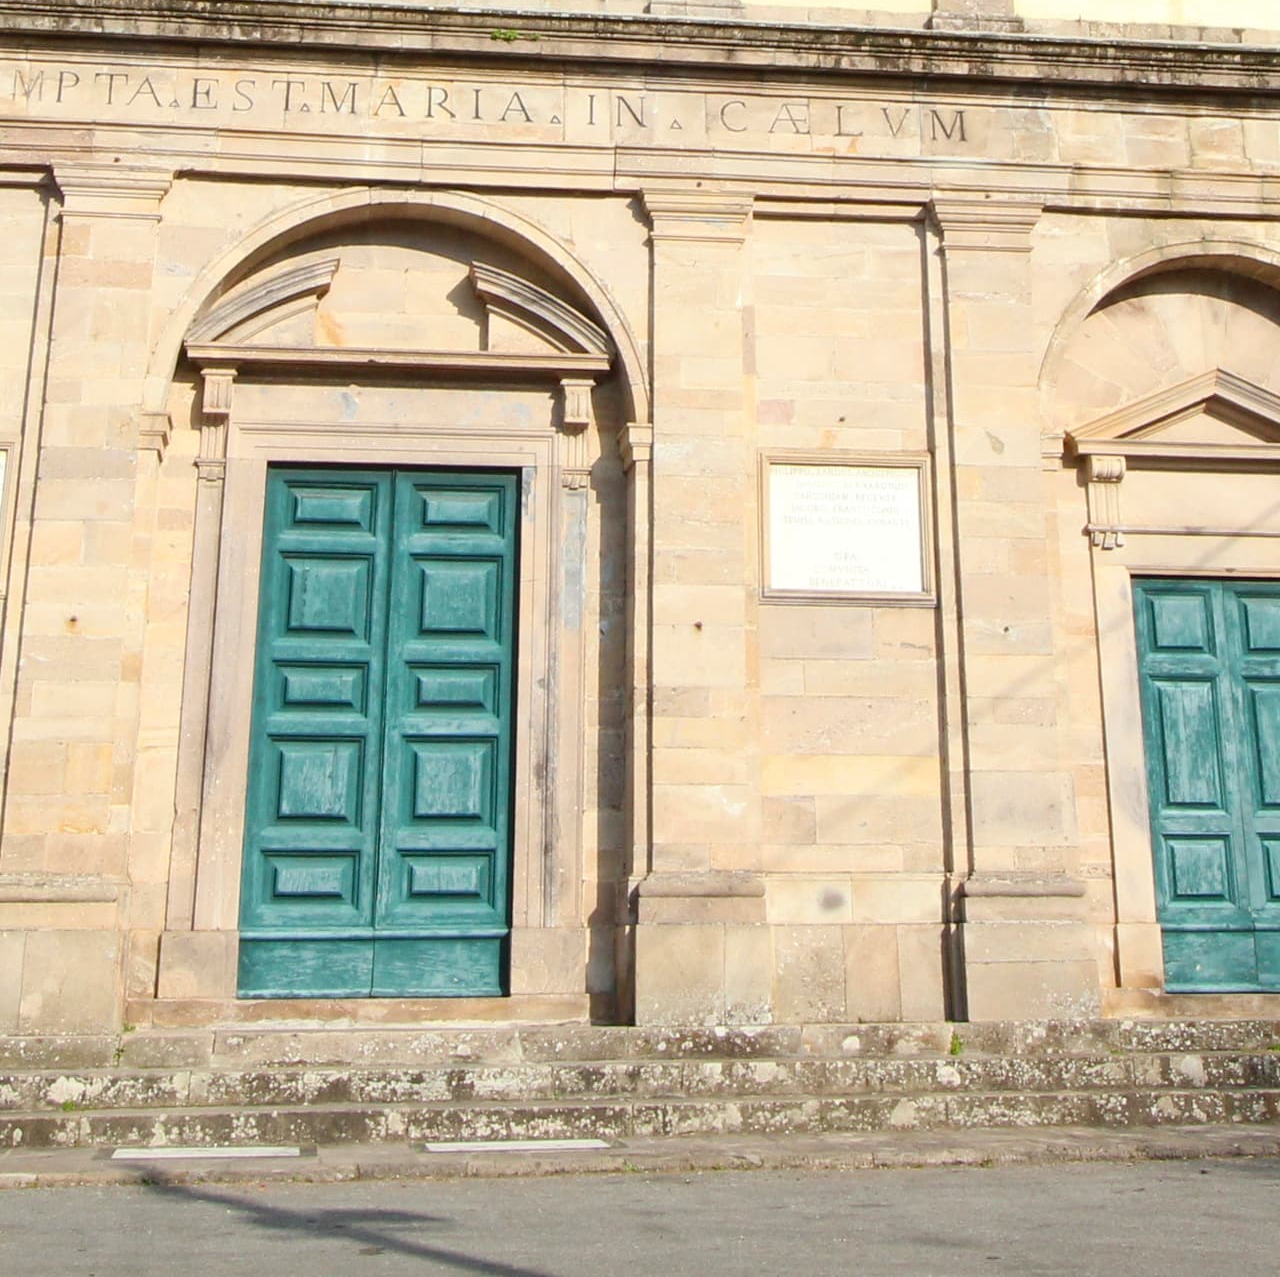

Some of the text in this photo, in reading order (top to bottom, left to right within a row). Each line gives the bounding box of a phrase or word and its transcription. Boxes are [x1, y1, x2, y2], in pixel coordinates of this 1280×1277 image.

[190, 76, 305, 113] EST
[319, 81, 549, 123] MARIA
[587, 94, 648, 128] IN
